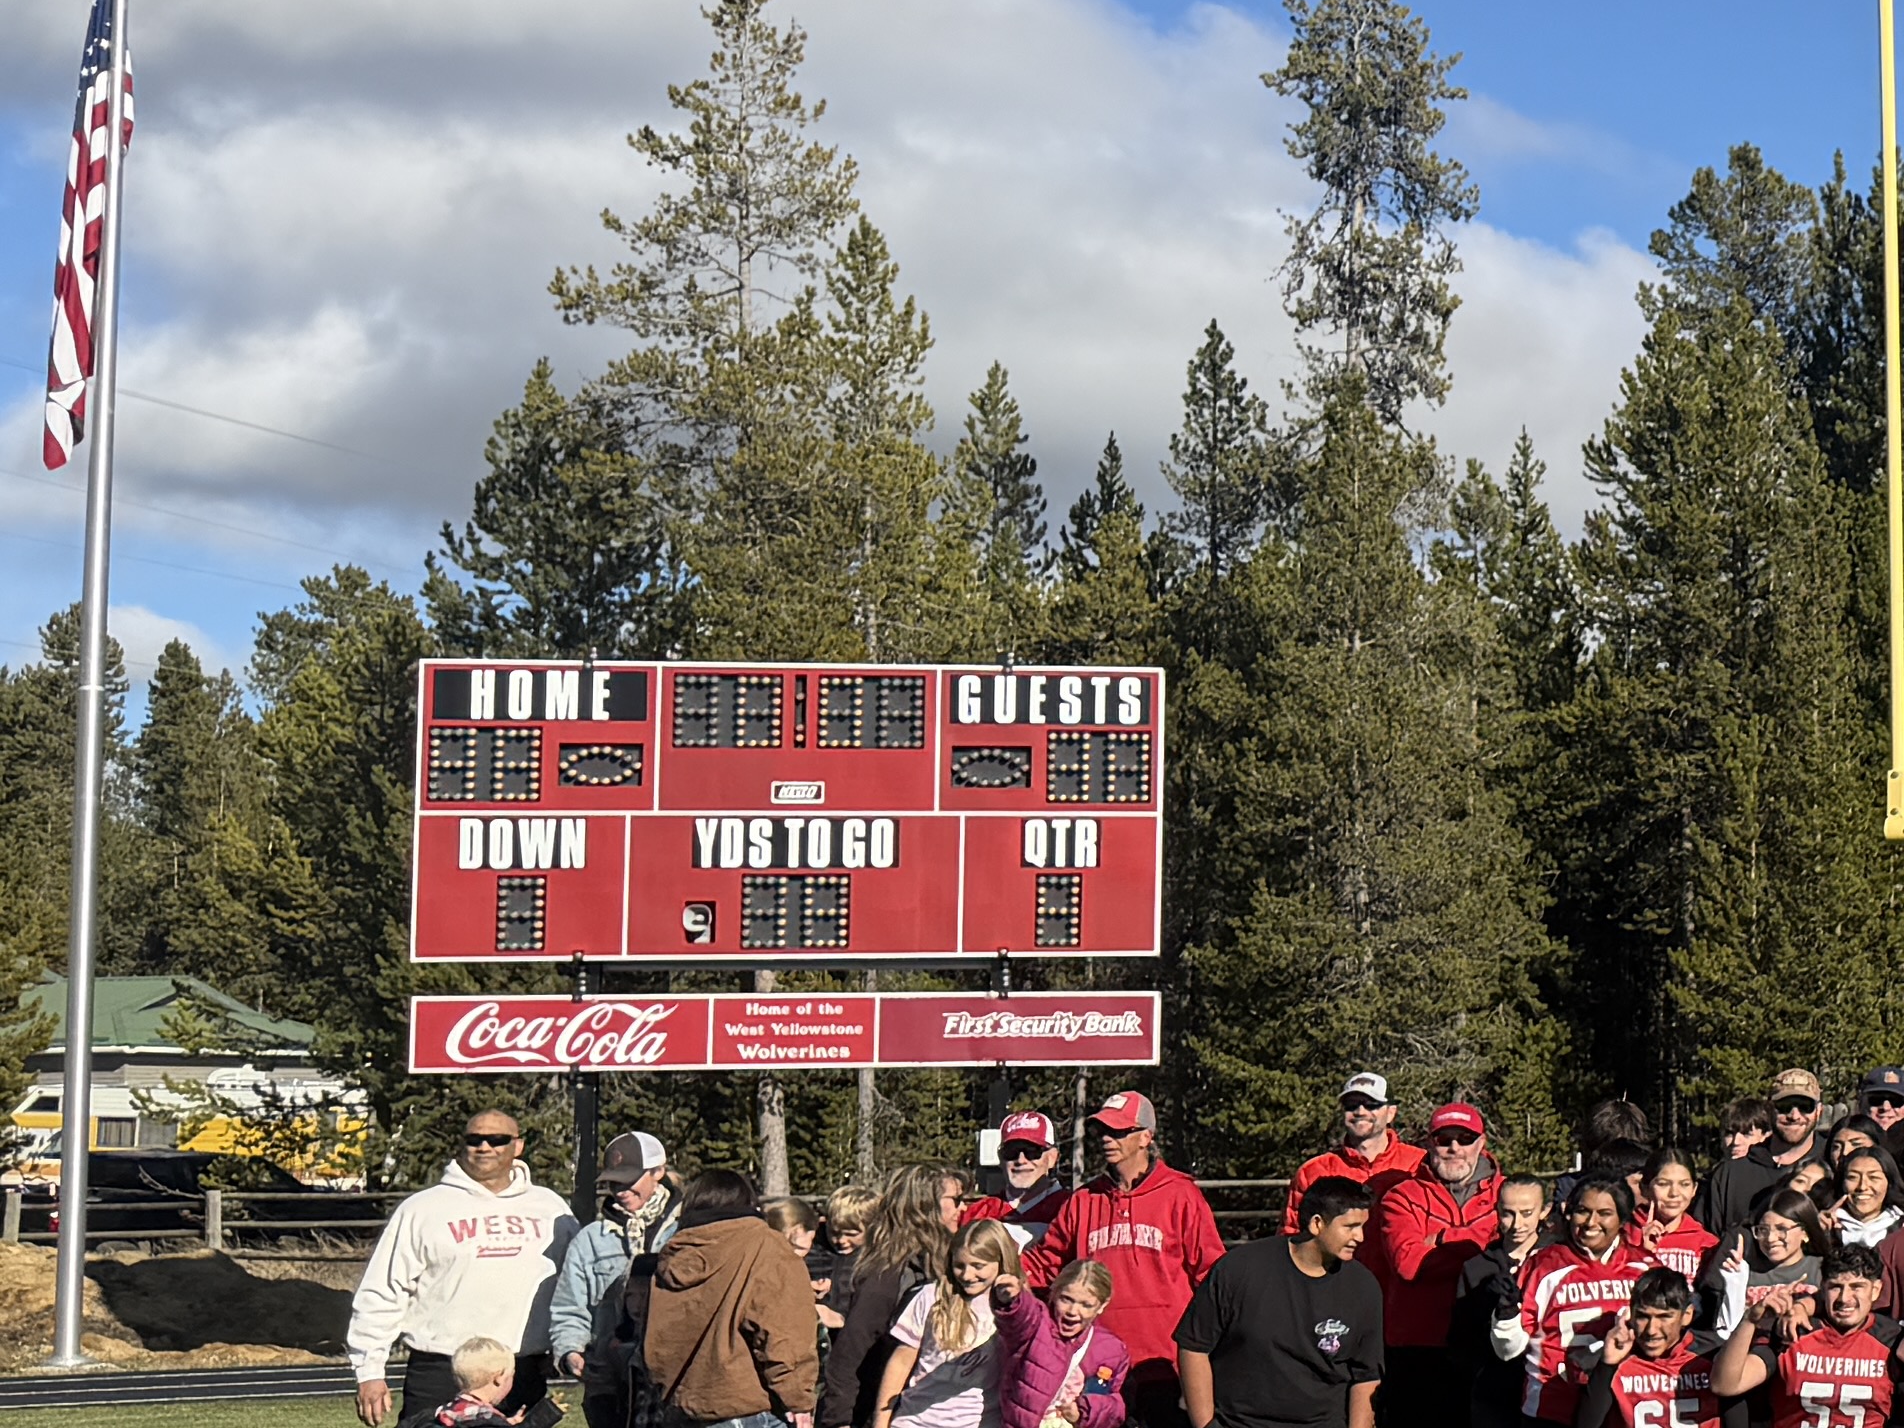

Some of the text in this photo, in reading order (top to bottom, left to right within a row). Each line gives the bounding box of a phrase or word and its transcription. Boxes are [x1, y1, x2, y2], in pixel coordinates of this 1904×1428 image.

[470, 669, 610, 721] HOME
[958, 674, 1142, 725] GUESTS
[459, 818, 587, 870] DOWN
[695, 818, 895, 869] YDS TO GO
[1024, 818, 1098, 869] QTR
[745, 1002, 844, 1016] Home of the
[445, 1001, 680, 1065] Coca-Cola
[724, 1022, 864, 1037] West Yellowstone
[944, 1012, 1140, 1040] First Security Bank
[736, 1043, 851, 1060] Wolverines
[447, 1215, 541, 1243] WEST
[1795, 1351, 1886, 1378] WOLVERINES
[1620, 1372, 1710, 1394] WOLVERINES
